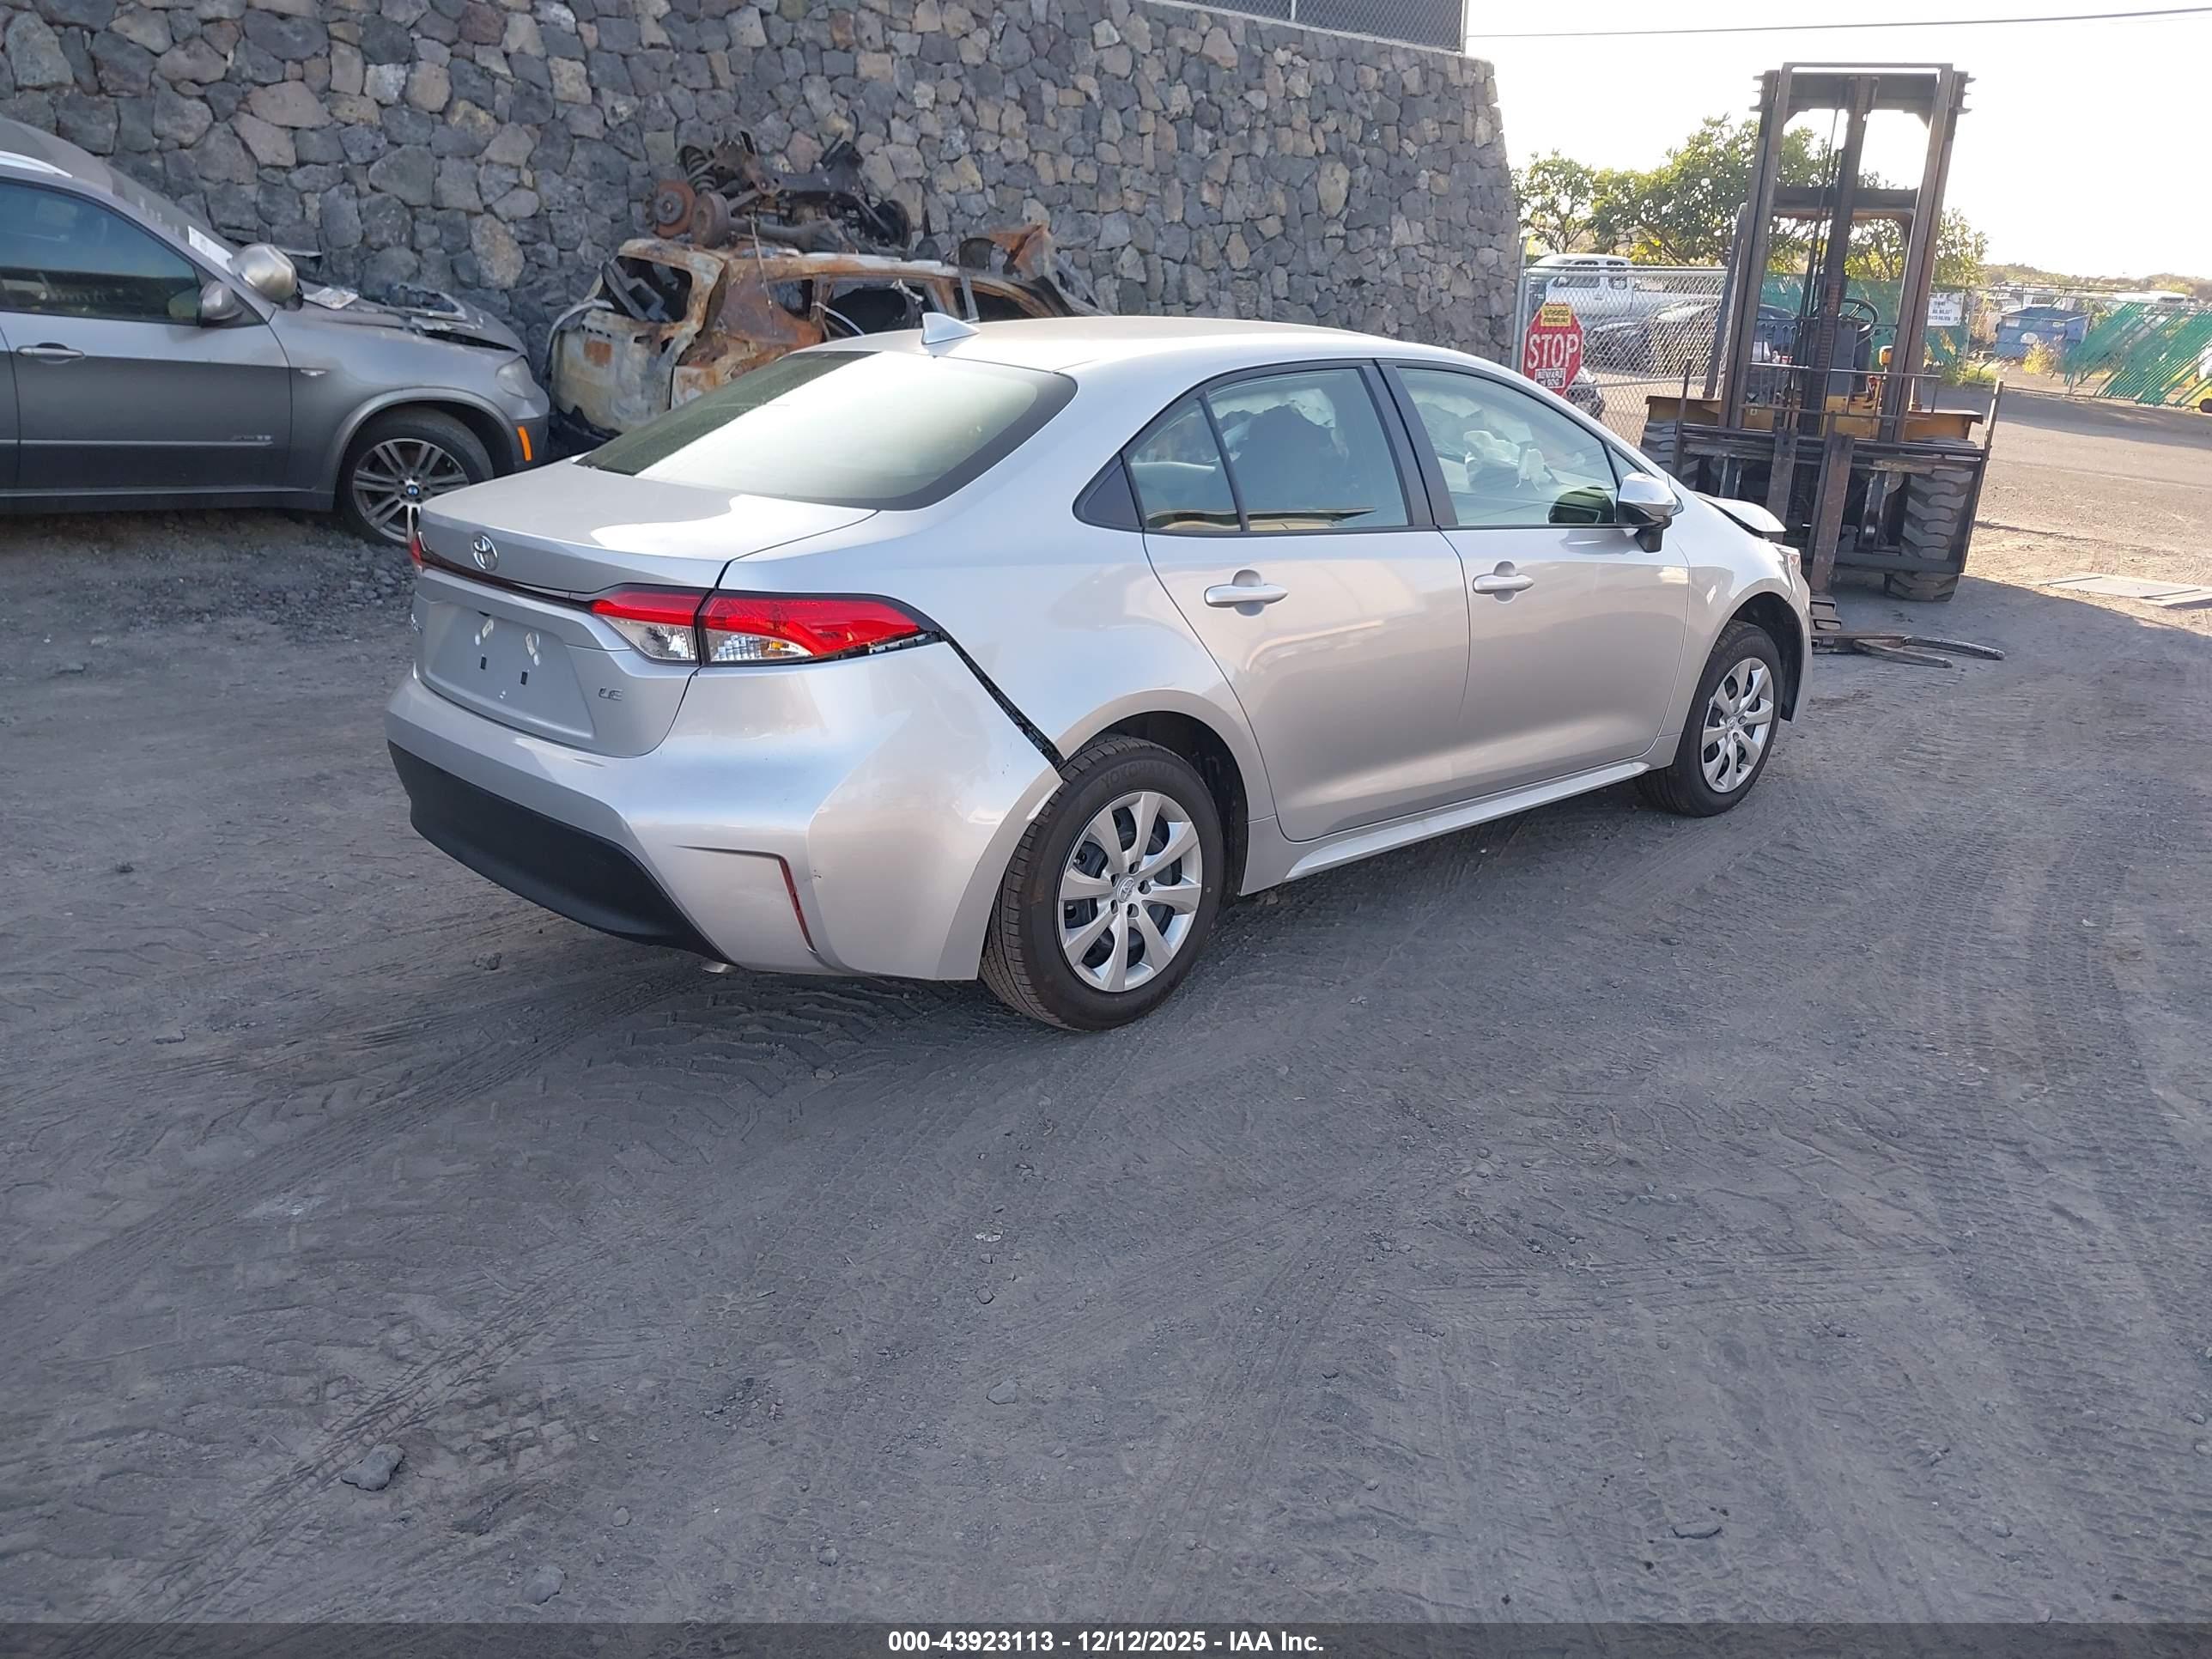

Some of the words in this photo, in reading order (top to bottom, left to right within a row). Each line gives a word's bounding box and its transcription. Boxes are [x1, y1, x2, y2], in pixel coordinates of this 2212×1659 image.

[1527, 333, 1579, 369] STOP
[598, 687, 623, 702] LE
[1101, 762, 1176, 789] YOKOHAMA
